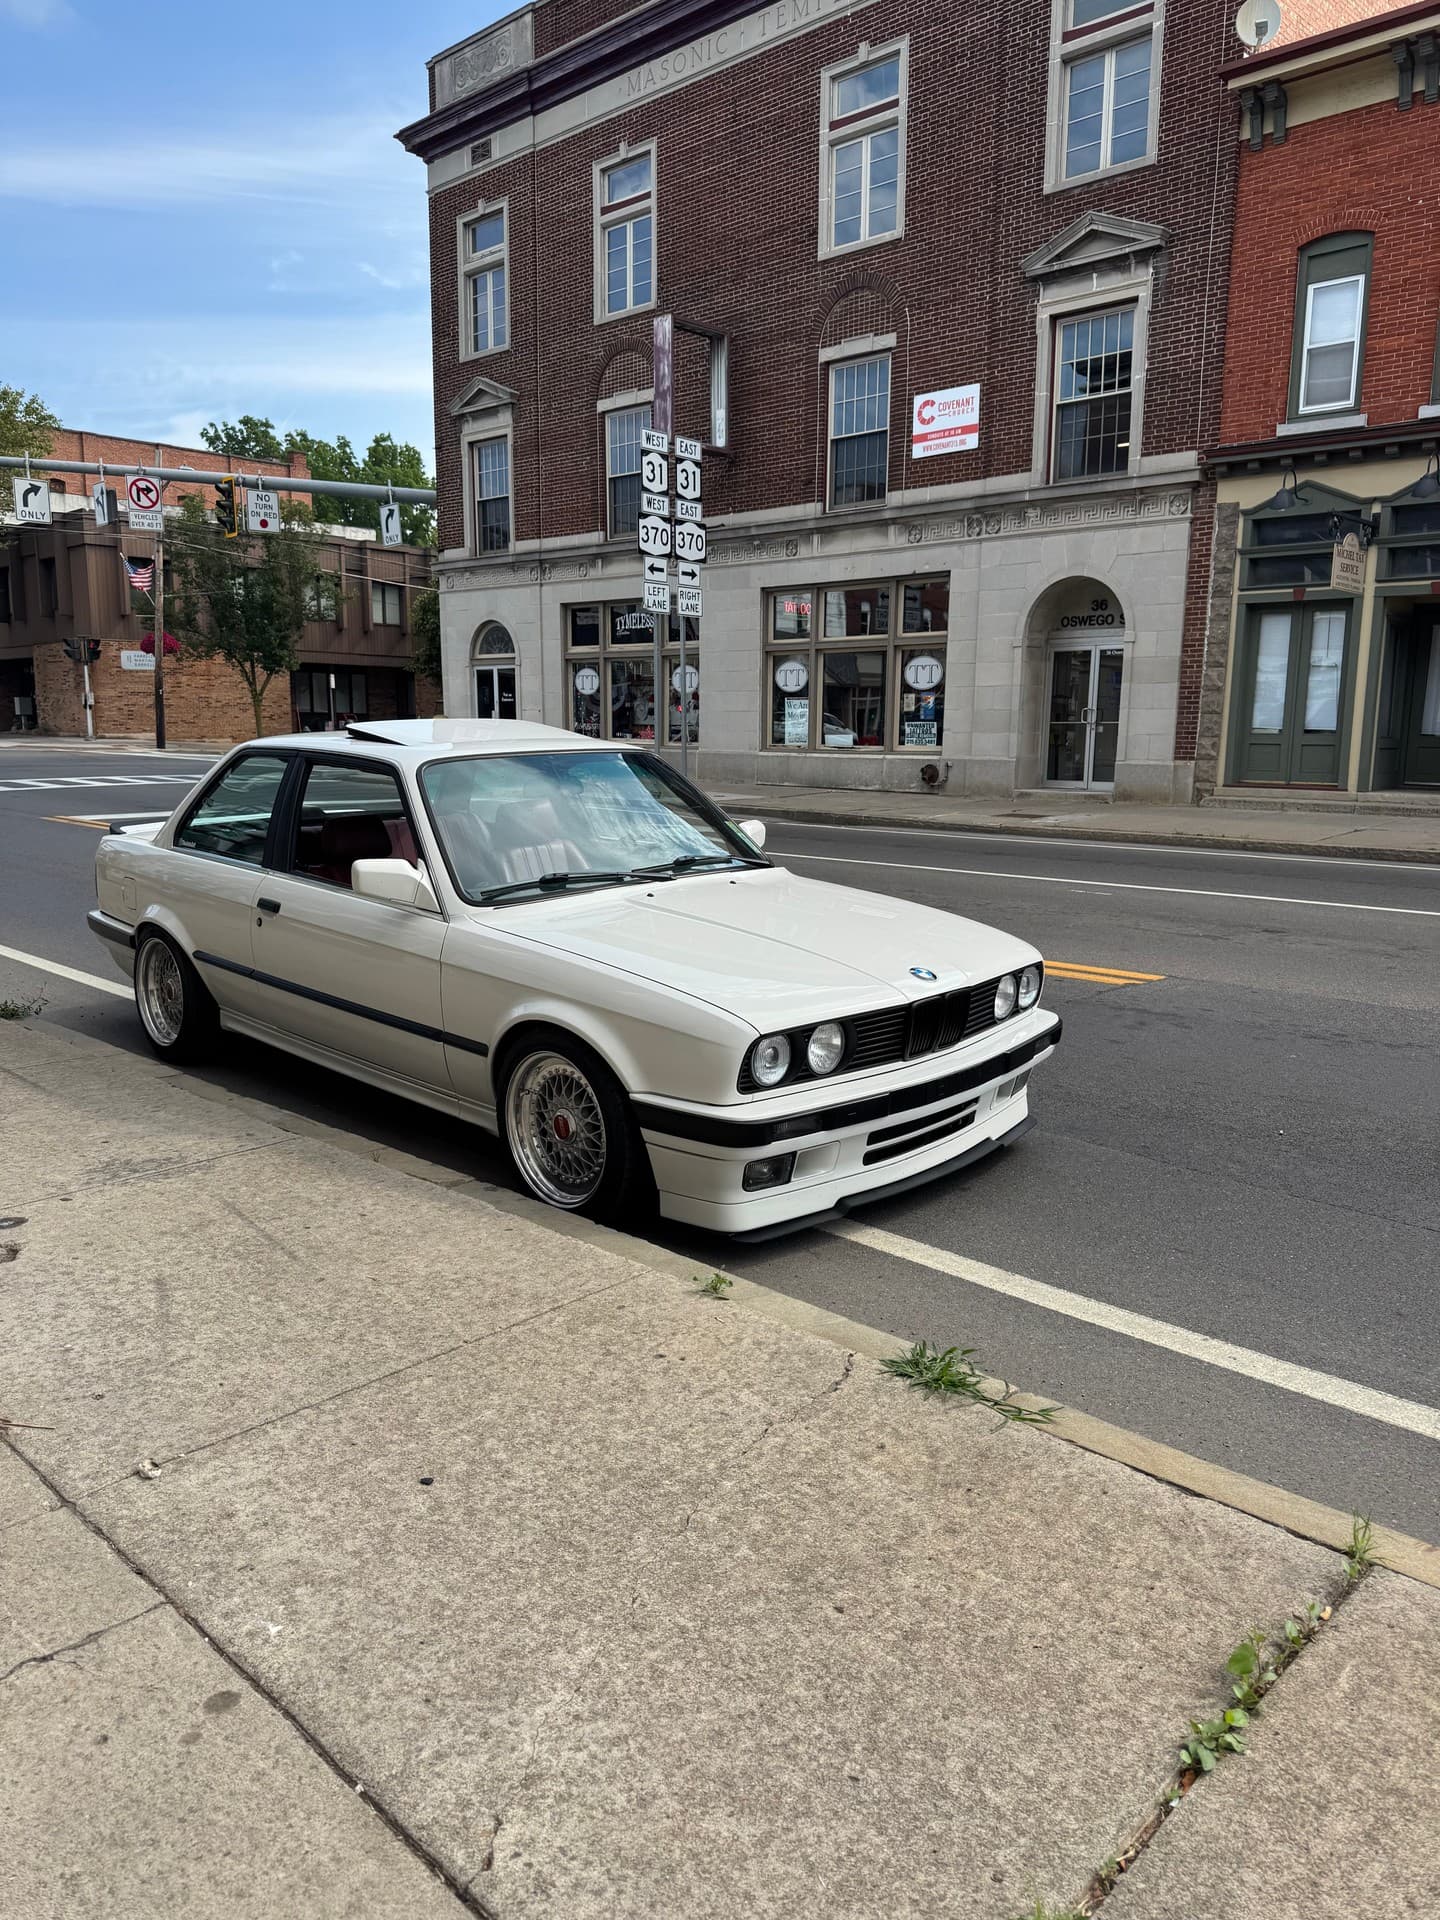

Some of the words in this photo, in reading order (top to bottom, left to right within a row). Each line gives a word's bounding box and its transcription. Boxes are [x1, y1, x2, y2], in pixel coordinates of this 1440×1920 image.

[626, 31, 728, 97] MASONIC
[938, 397, 975, 412] COVENANT
[948, 407, 975, 416] CHURCH
[645, 431, 665, 448] WEST
[679, 440, 697, 456] EAST
[646, 460, 663, 485] 31
[680, 468, 696, 492] 31
[256, 494, 271, 503] NO
[646, 495, 665, 511] WEST
[254, 502, 273, 511] TURN
[680, 503, 698, 518] EAST
[20, 509, 46, 521] ONLY
[134, 513, 158, 521] VEHICLES
[250, 510, 262, 518] ON
[263, 511, 278, 520] RED
[131, 520, 145, 528] OVER
[385, 534, 400, 544] ONLY
[641, 525, 669, 546] 370
[677, 531, 704, 552] 370
[1340, 563, 1359, 575] SERVICE
[648, 586, 666, 597] LEFT
[680, 590, 700, 601] RIGHT
[647, 599, 667, 610] LANE
[681, 602, 700, 613] LANE
[1091, 600, 1108, 611] 36
[615, 613, 656, 630] TYMELESS
[1061, 614, 1114, 627] OSWEGO
[779, 668, 805, 688] TT
[908, 664, 938, 684] TT
